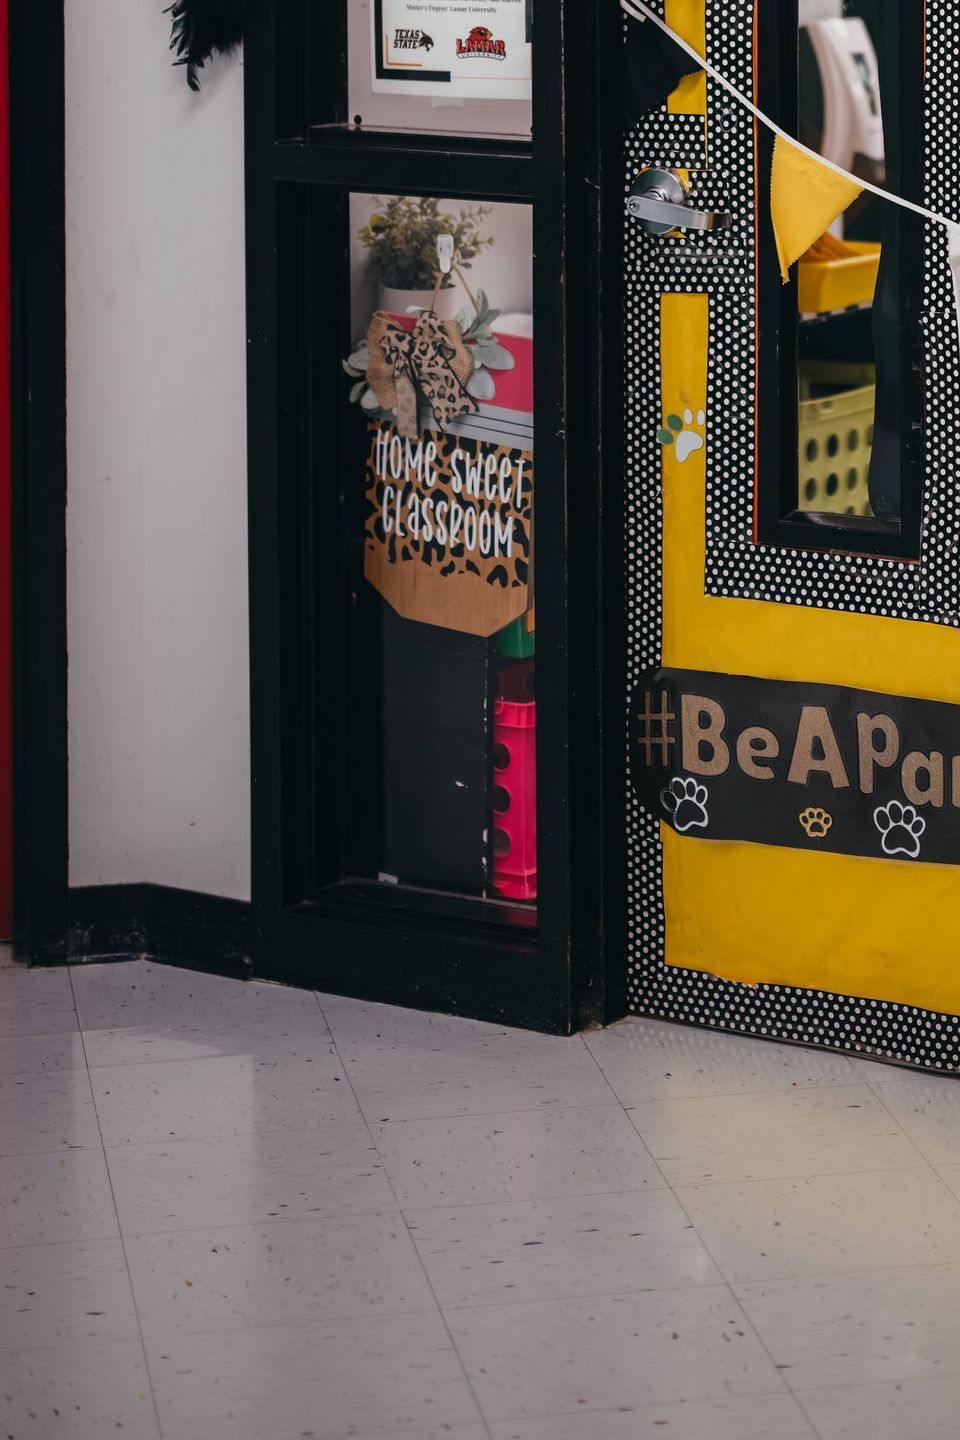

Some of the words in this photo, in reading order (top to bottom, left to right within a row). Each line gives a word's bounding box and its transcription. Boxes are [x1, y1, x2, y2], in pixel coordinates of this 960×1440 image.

[468, 6, 497, 14] University
[395, 29, 420, 40] TEXAS
[393, 40, 418, 49] STATE
[456, 38, 506, 57] LAMAR
